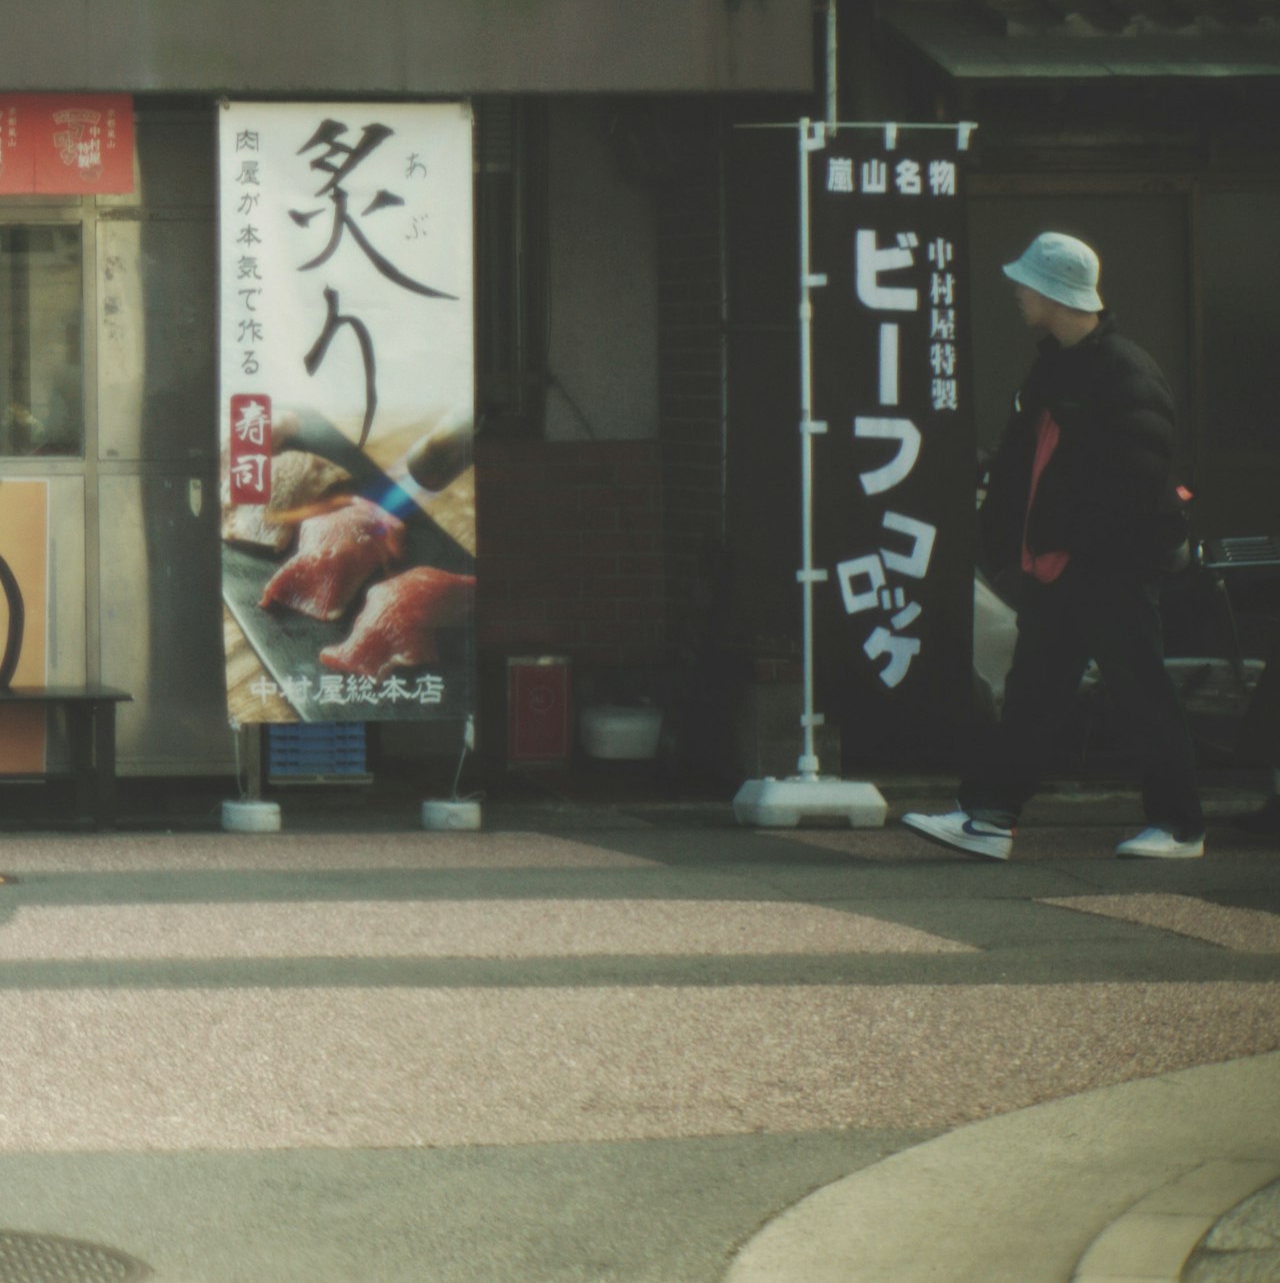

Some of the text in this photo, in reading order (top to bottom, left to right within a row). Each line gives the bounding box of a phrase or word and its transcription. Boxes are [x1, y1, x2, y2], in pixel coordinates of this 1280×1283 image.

[827, 157, 956, 196] 嵐山名物
[235, 128, 264, 376] 肉屋が本気で作る
[287, 117, 460, 448] 炙り
[928, 237, 958, 412] 中村屋特製
[231, 400, 272, 493] 寿司
[250, 674, 444, 704] 中村屋総本店
